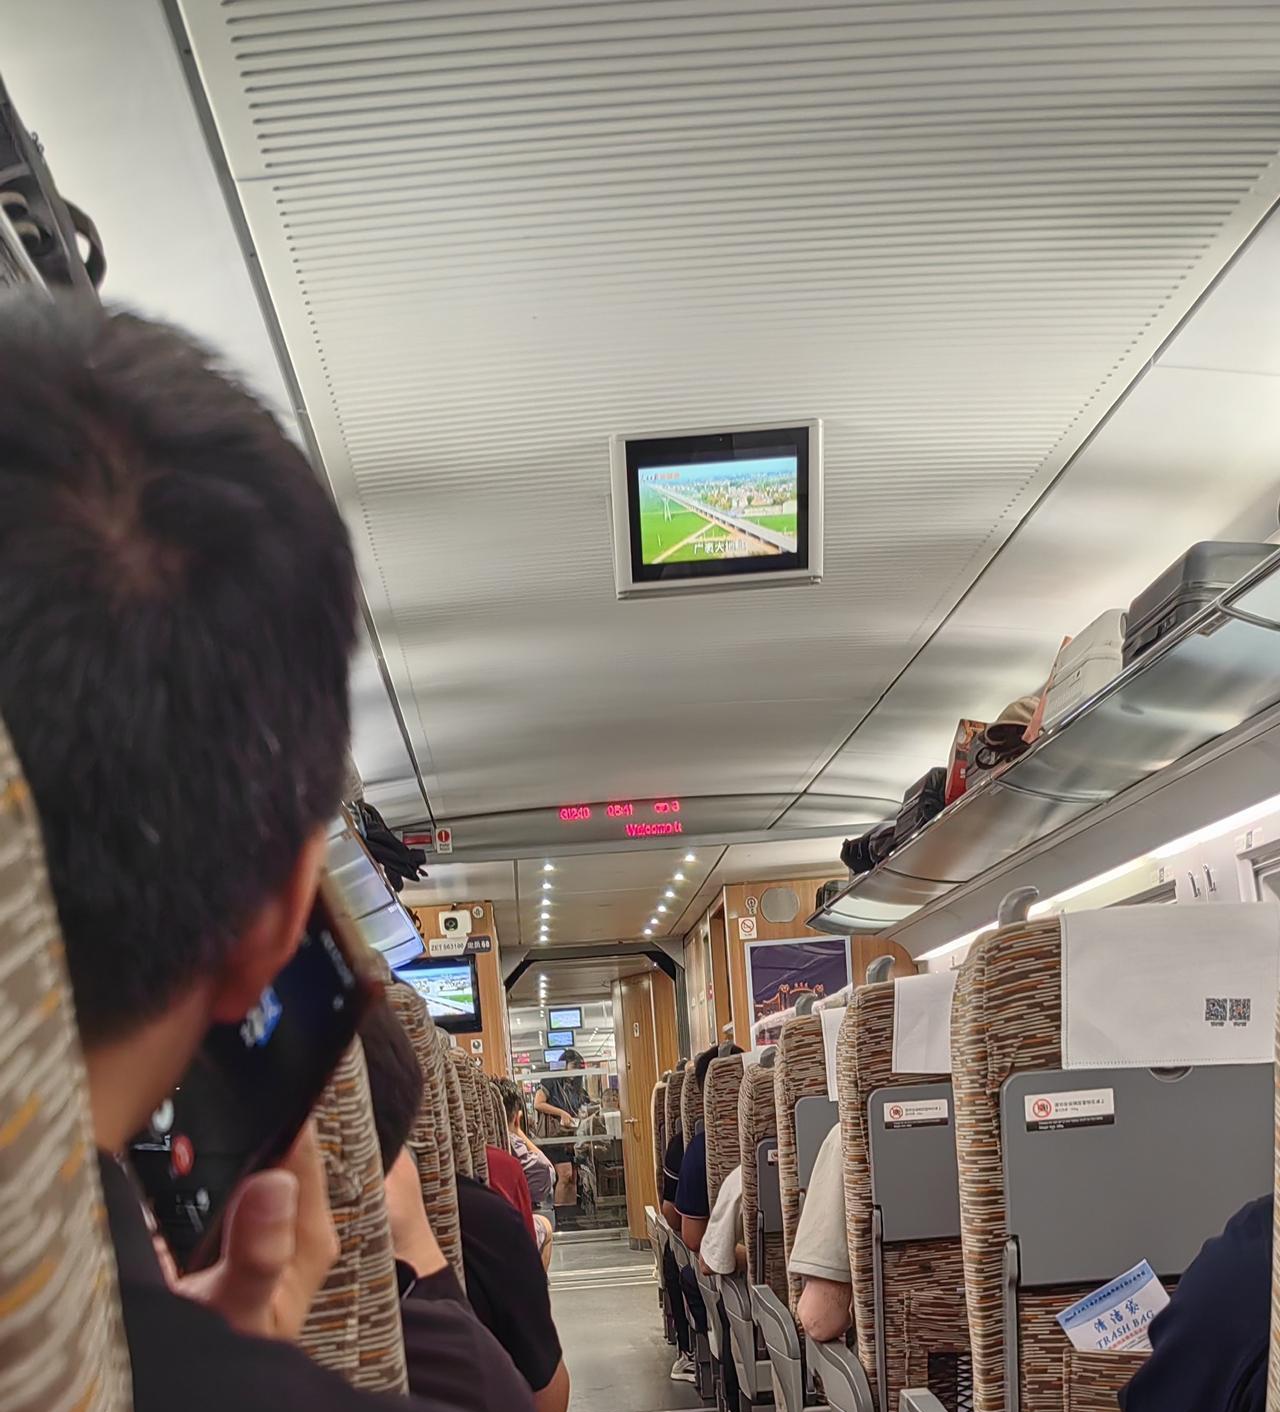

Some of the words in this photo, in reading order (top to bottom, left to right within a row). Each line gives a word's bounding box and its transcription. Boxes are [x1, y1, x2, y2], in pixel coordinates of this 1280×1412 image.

[1094, 1298, 1140, 1333] 清洁袋
[1096, 1323, 1131, 1349] TRASH
[1132, 1310, 1154, 1328] BAG
